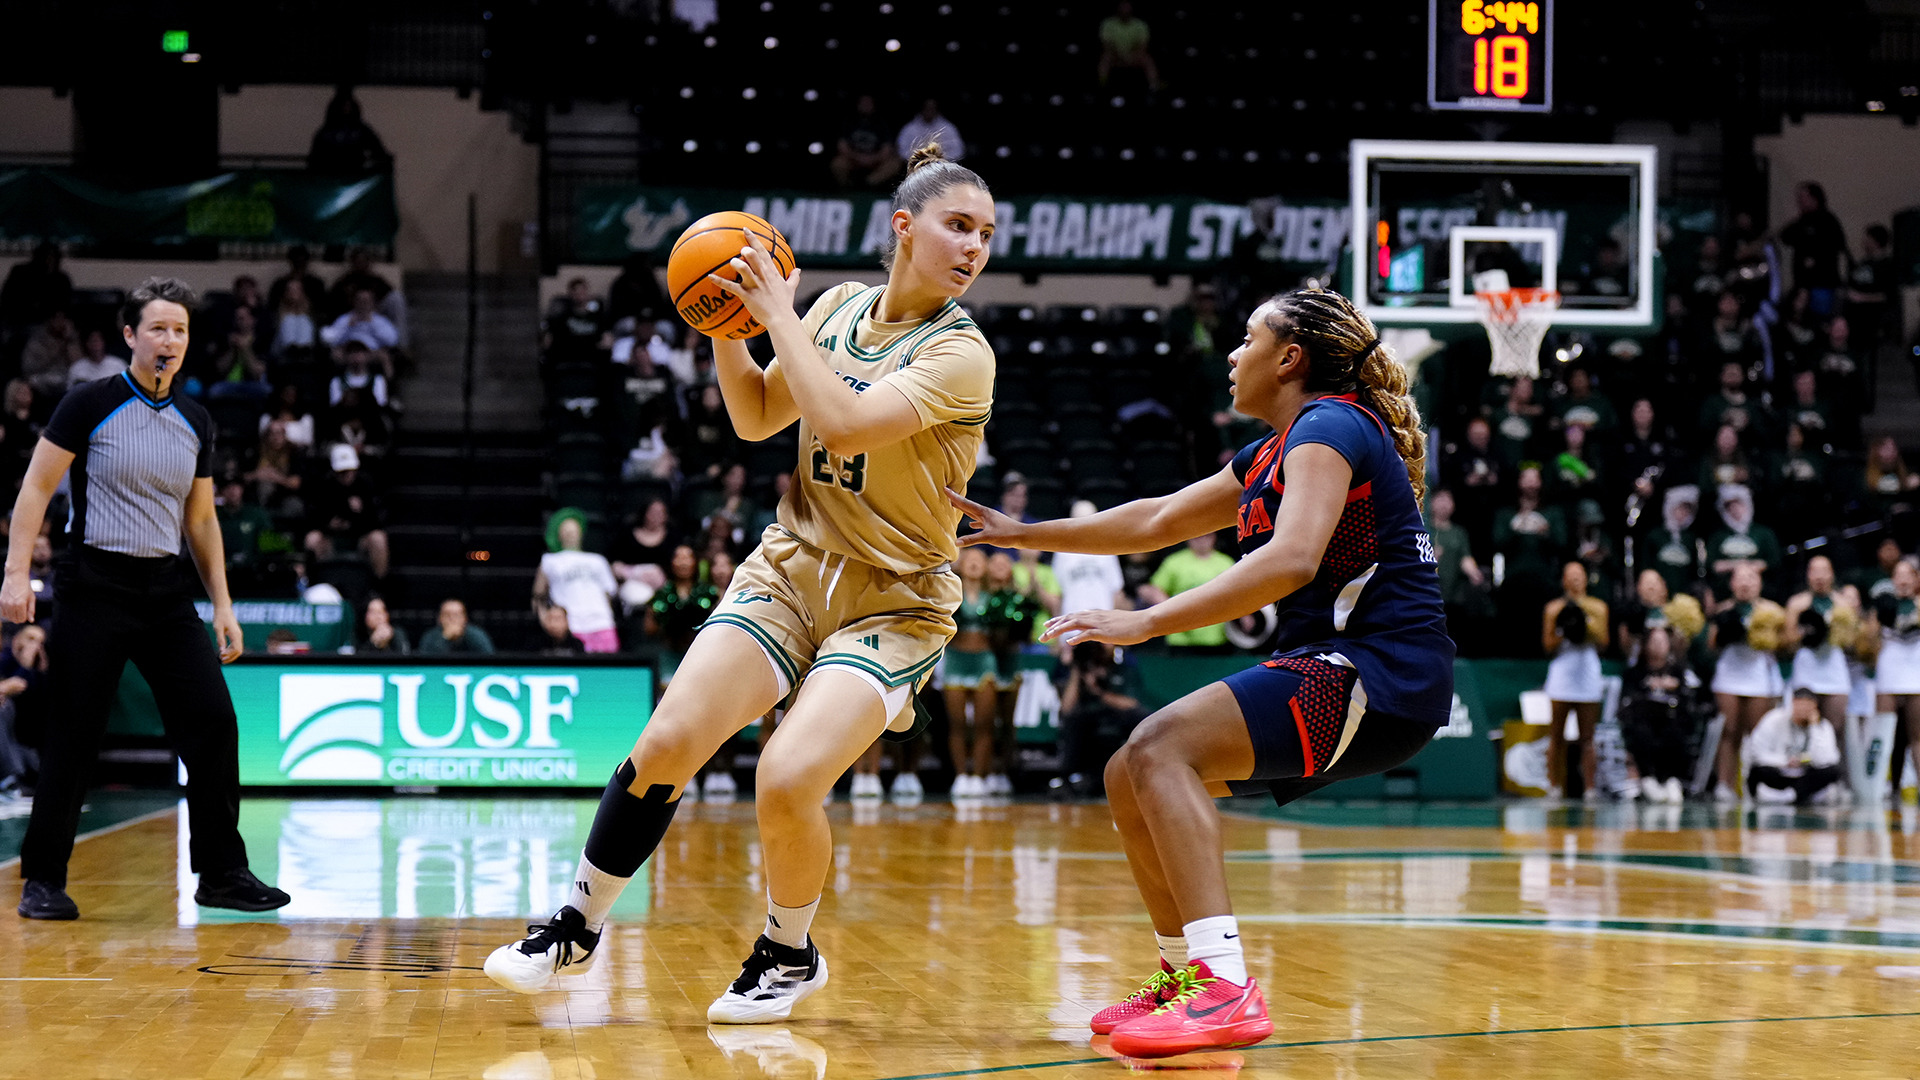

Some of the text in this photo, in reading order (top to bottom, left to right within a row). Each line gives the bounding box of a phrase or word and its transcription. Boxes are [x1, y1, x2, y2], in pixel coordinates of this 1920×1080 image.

[1461, 0, 1539, 35] 6:44
[1473, 35, 1529, 98] 18
[860, 200, 1173, 259] AR-RAHIM
[810, 436, 868, 494] 23
[387, 673, 580, 749] USF
[387, 757, 578, 781] CREDIT UNION
